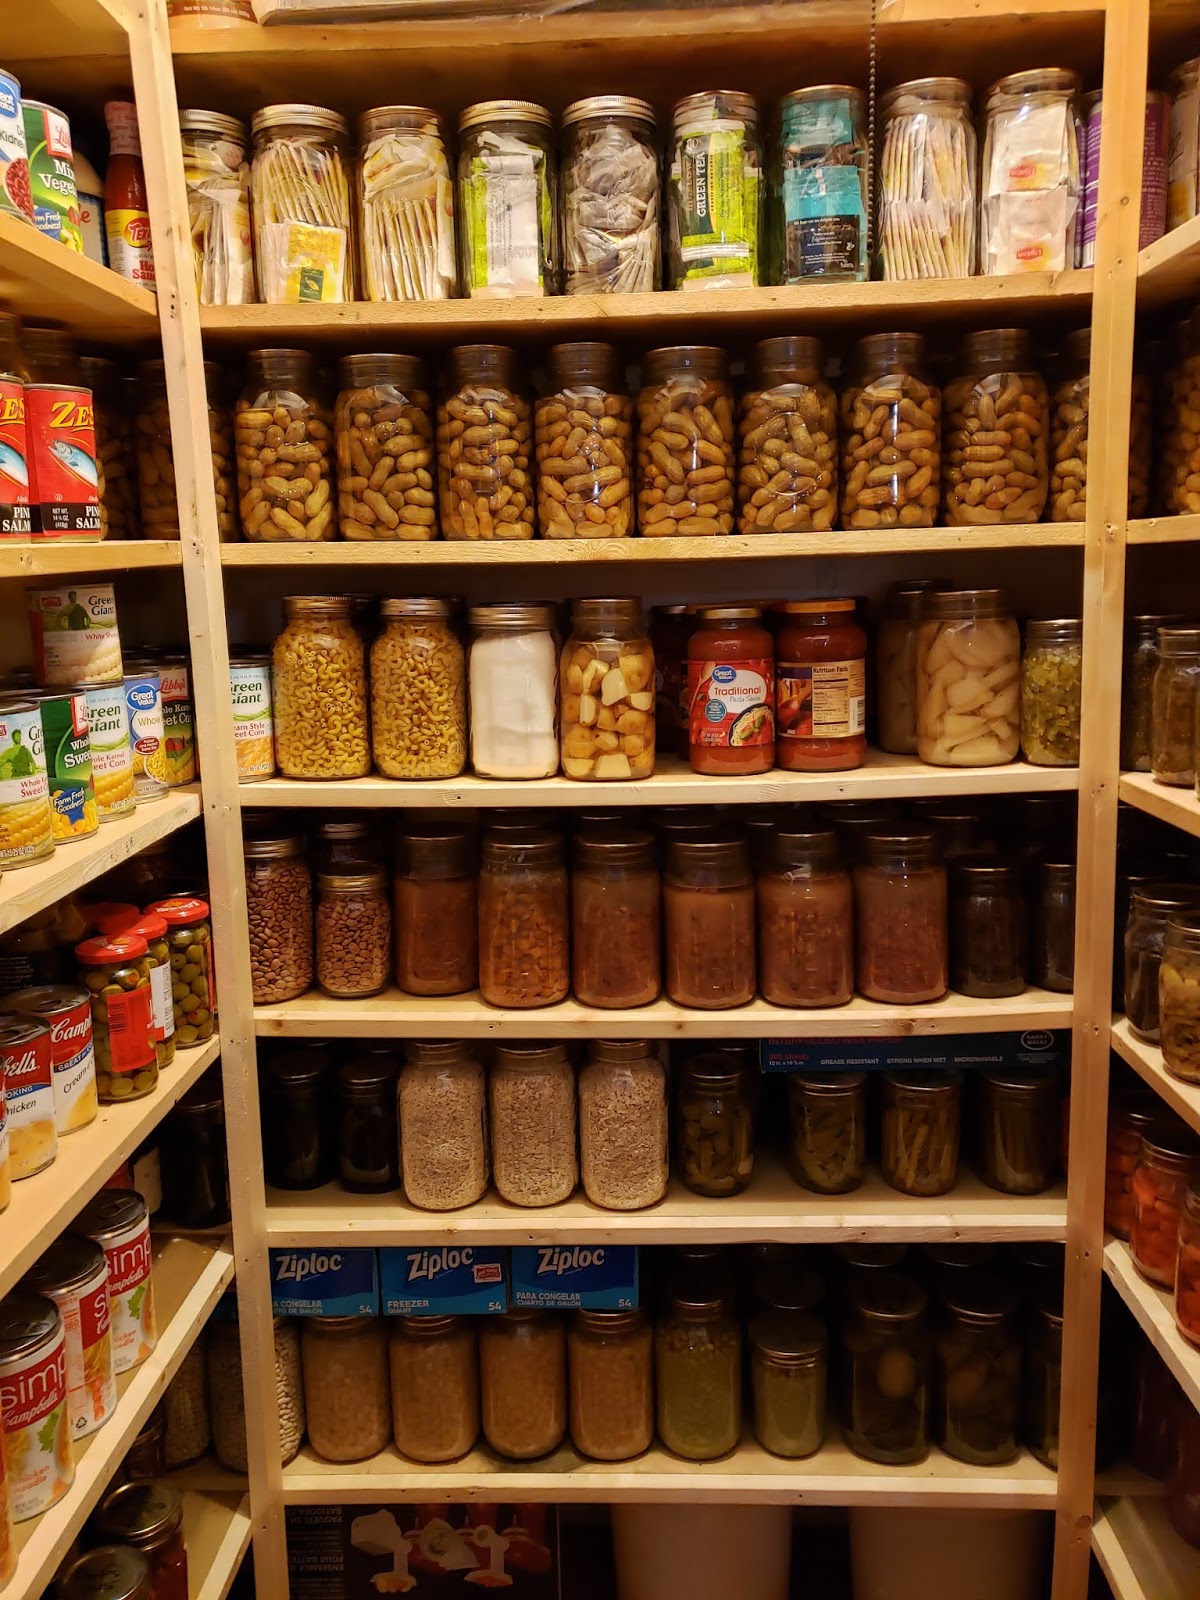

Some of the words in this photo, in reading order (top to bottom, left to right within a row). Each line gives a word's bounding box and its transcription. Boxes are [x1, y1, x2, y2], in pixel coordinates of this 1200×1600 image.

[697, 152, 707, 176] TEA
[697, 178, 707, 218] GREEN
[714, 669, 732, 677] Great
[161, 677, 185, 694] Libby's
[714, 686, 761, 695] Traditional
[131, 691, 153, 701] Great
[250, 722, 265, 731] Style
[249, 729, 265, 737] Corn
[106, 751, 125, 761] Kernel
[109, 759, 126, 769] Corn
[20, 779, 41, 789] Whole
[20, 786, 43, 798] Sweet
[53, 796, 71, 807] Farm
[71, 787, 86, 802] Fresh
[58, 1058, 82, 1072] GREAT
[63, 1067, 87, 1094] Cream
[407, 1247, 474, 1282] Ziploc
[537, 1247, 605, 1276] Ziploc
[275, 1252, 343, 1282] Ziploc
[516, 1292, 537, 1300] PARA
[538, 1292, 581, 1301] CONGELAR
[280, 1300, 322, 1308] CONGELAR
[387, 1300, 429, 1308] FREEZER
[488, 1302, 502, 1311] 54
[618, 1299, 632, 1307] 54
[359, 1305, 372, 1314] 54
[1, 1388, 59, 1427] Campbell's
